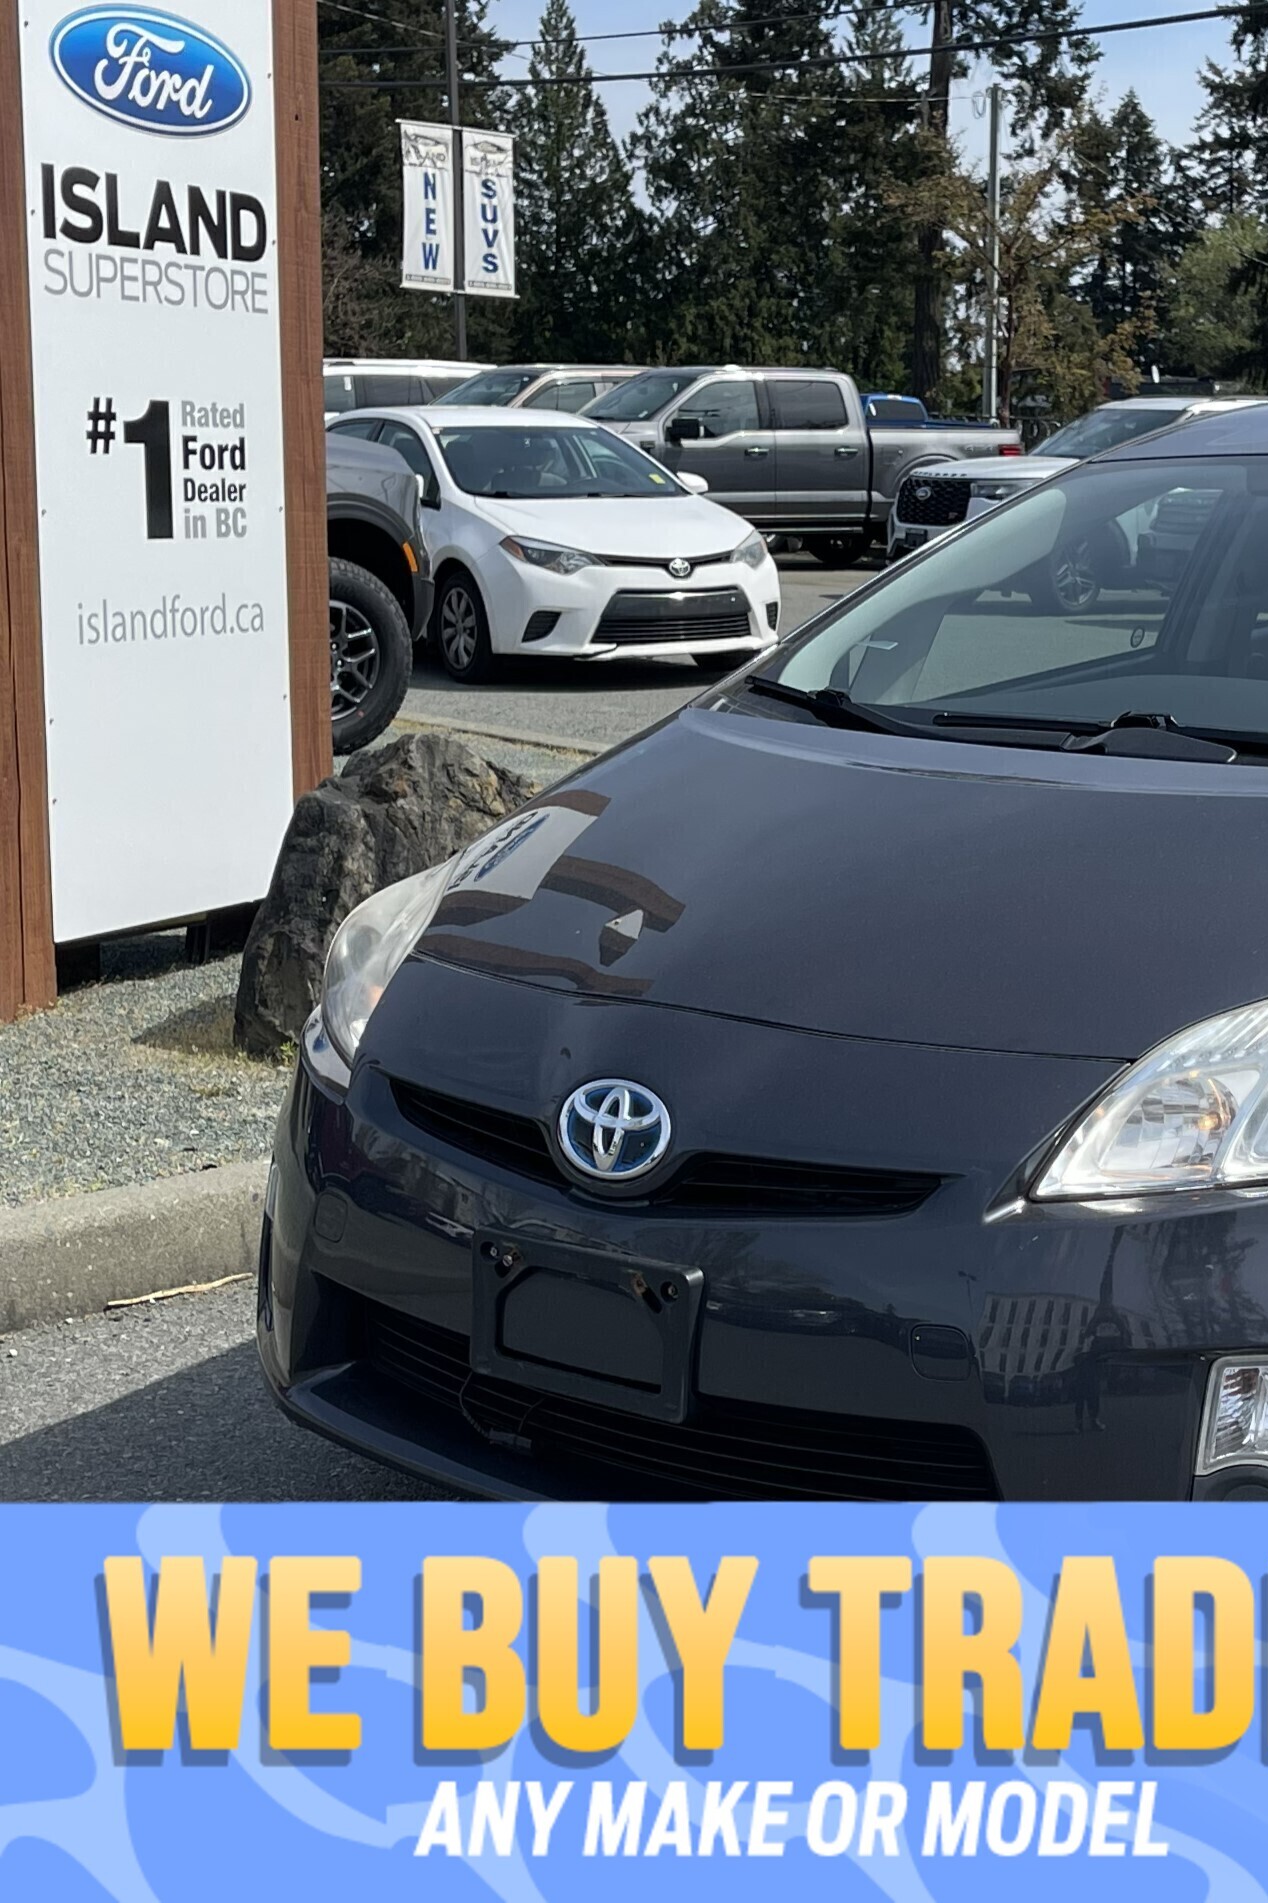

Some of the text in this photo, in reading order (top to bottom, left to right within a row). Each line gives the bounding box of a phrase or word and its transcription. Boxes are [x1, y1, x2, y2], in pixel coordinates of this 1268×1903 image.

[94, 22, 215, 119] Ford
[41, 162, 267, 262] ISLAND
[421, 171, 440, 271] NEW
[43, 248, 269, 314] SUPERSTORE
[181, 399, 246, 429] Rated
[86, 397, 174, 540] #1
[182, 435, 246, 471] Ford
[183, 477, 247, 503] Dealer
[184, 506, 248, 540] in BC
[77, 593, 265, 645] islandford.ca
